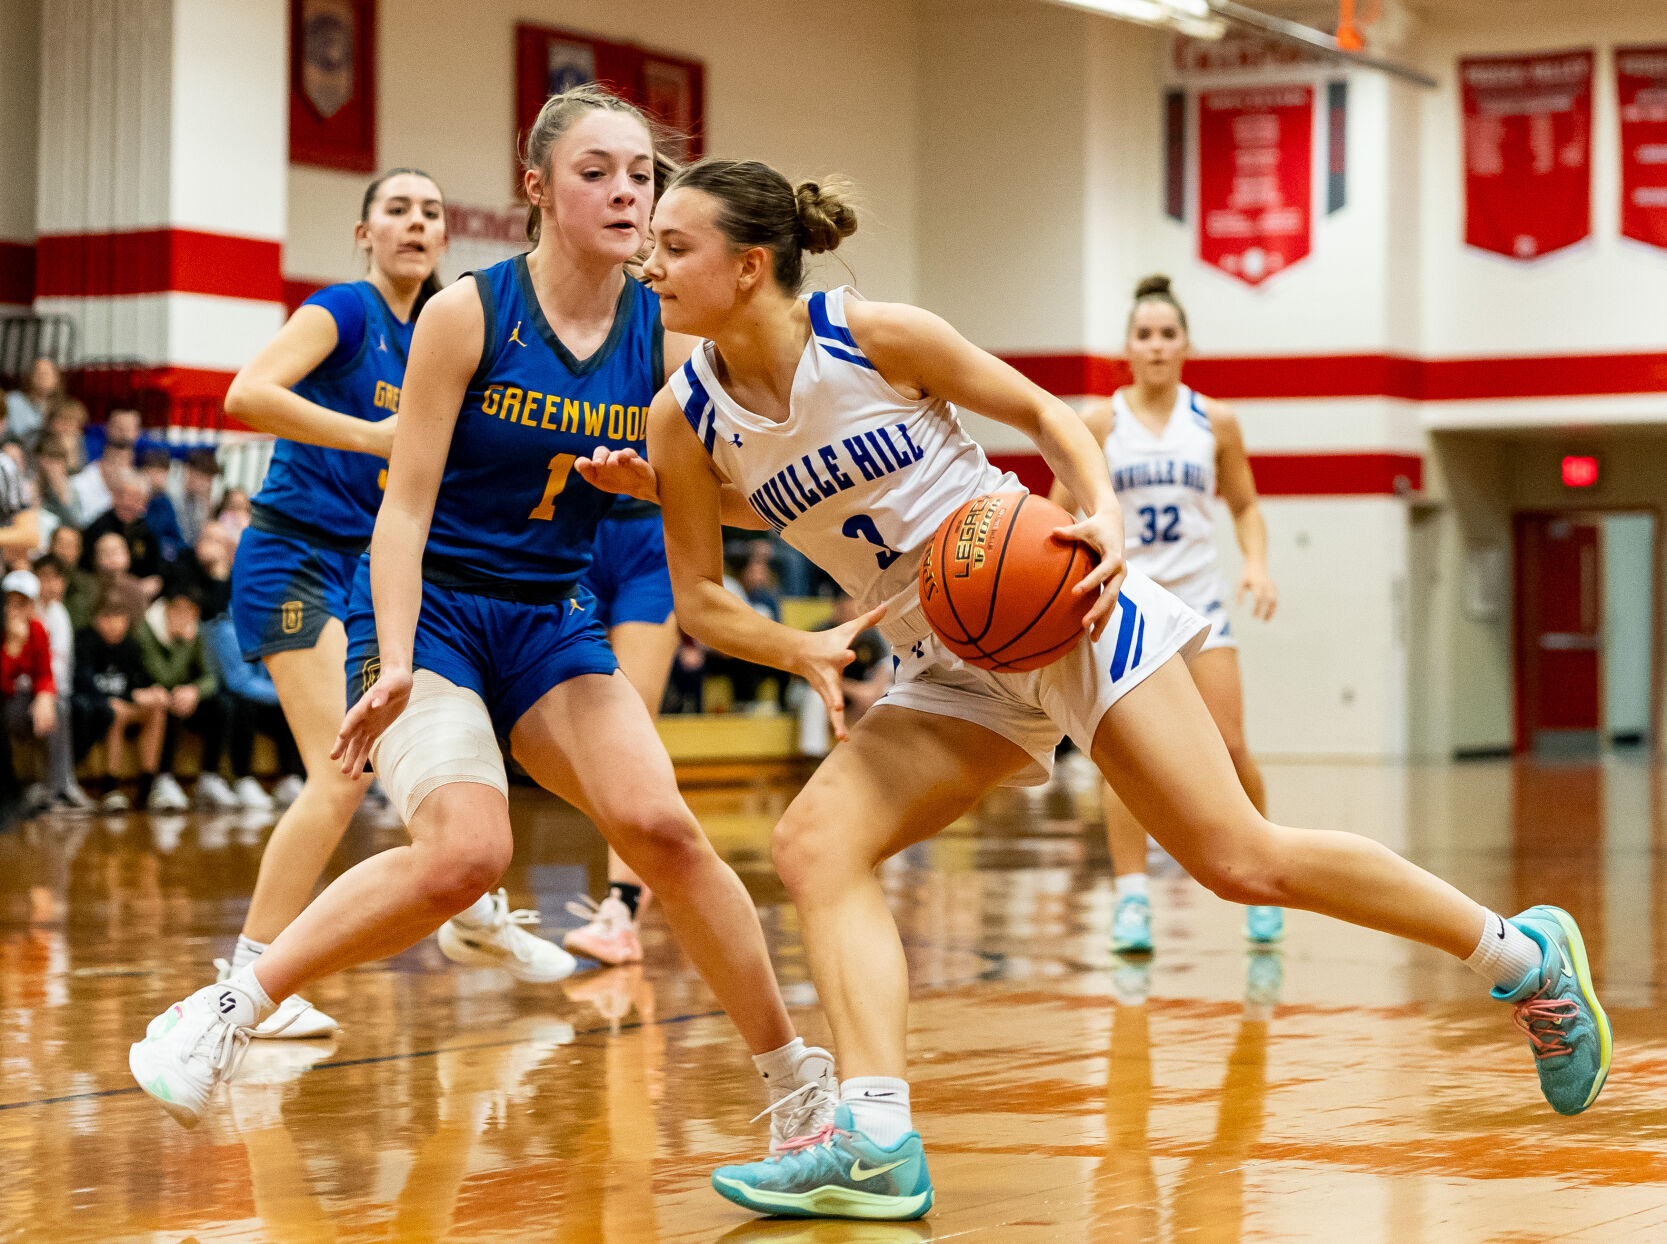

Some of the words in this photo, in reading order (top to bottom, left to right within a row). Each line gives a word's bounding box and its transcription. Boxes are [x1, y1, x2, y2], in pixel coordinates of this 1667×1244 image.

[842, 423, 924, 482] HILL
[527, 453, 576, 521] 1
[1137, 504, 1181, 544] 32
